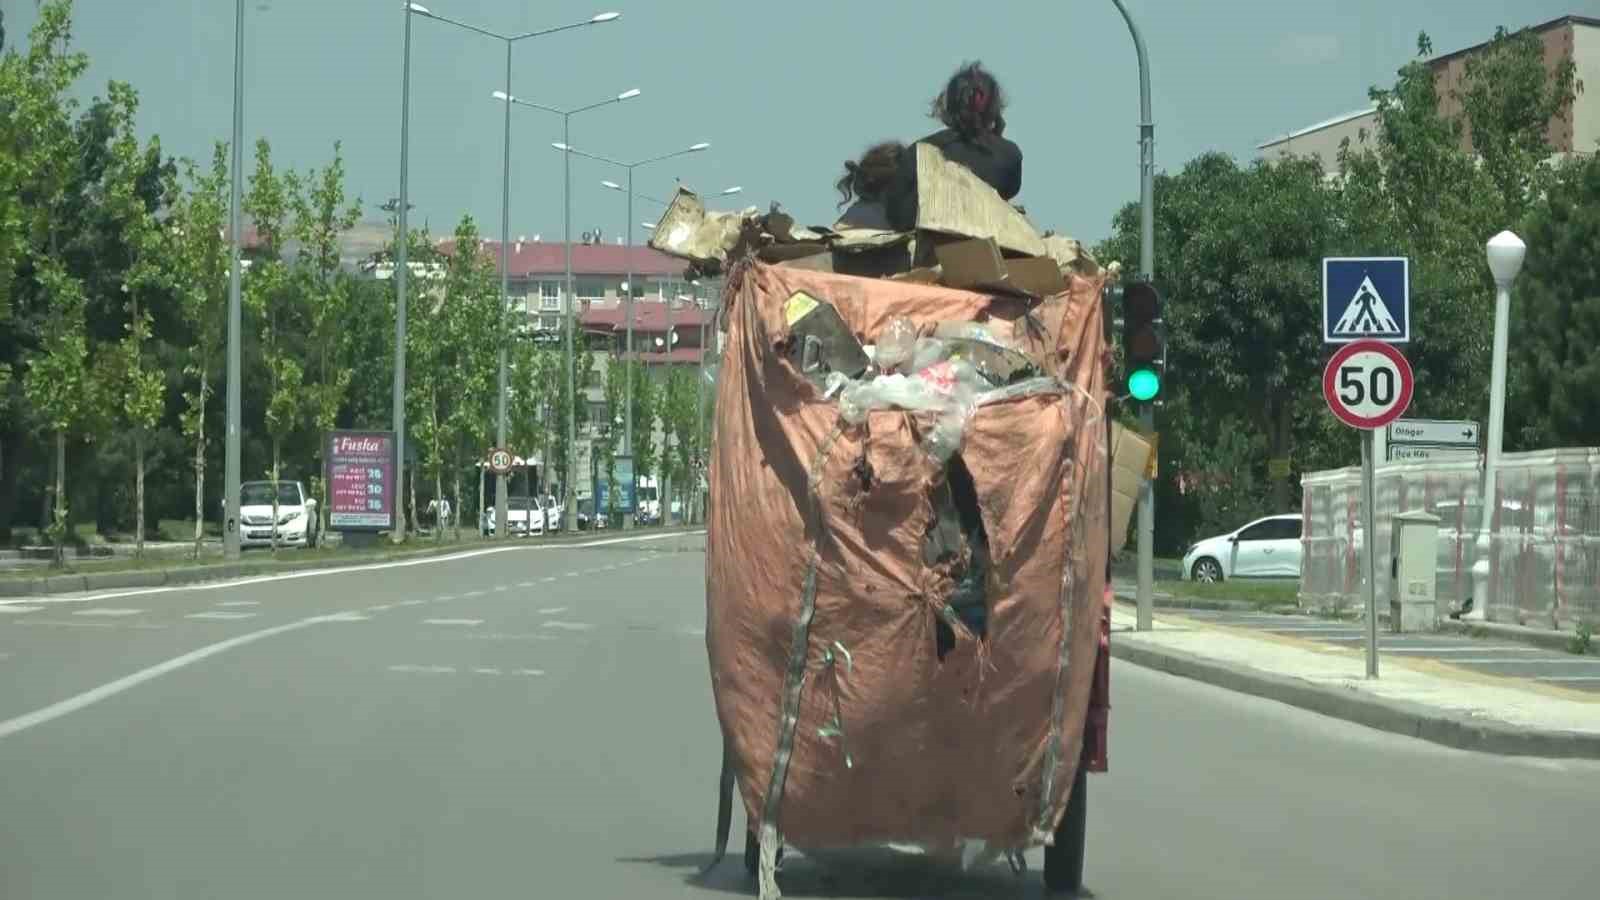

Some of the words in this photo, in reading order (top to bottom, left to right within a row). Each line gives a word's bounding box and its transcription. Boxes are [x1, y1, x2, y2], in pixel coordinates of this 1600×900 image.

[1341, 366, 1394, 406] 50
[340, 437, 379, 452] Fuska
[494, 454, 508, 466] 50
